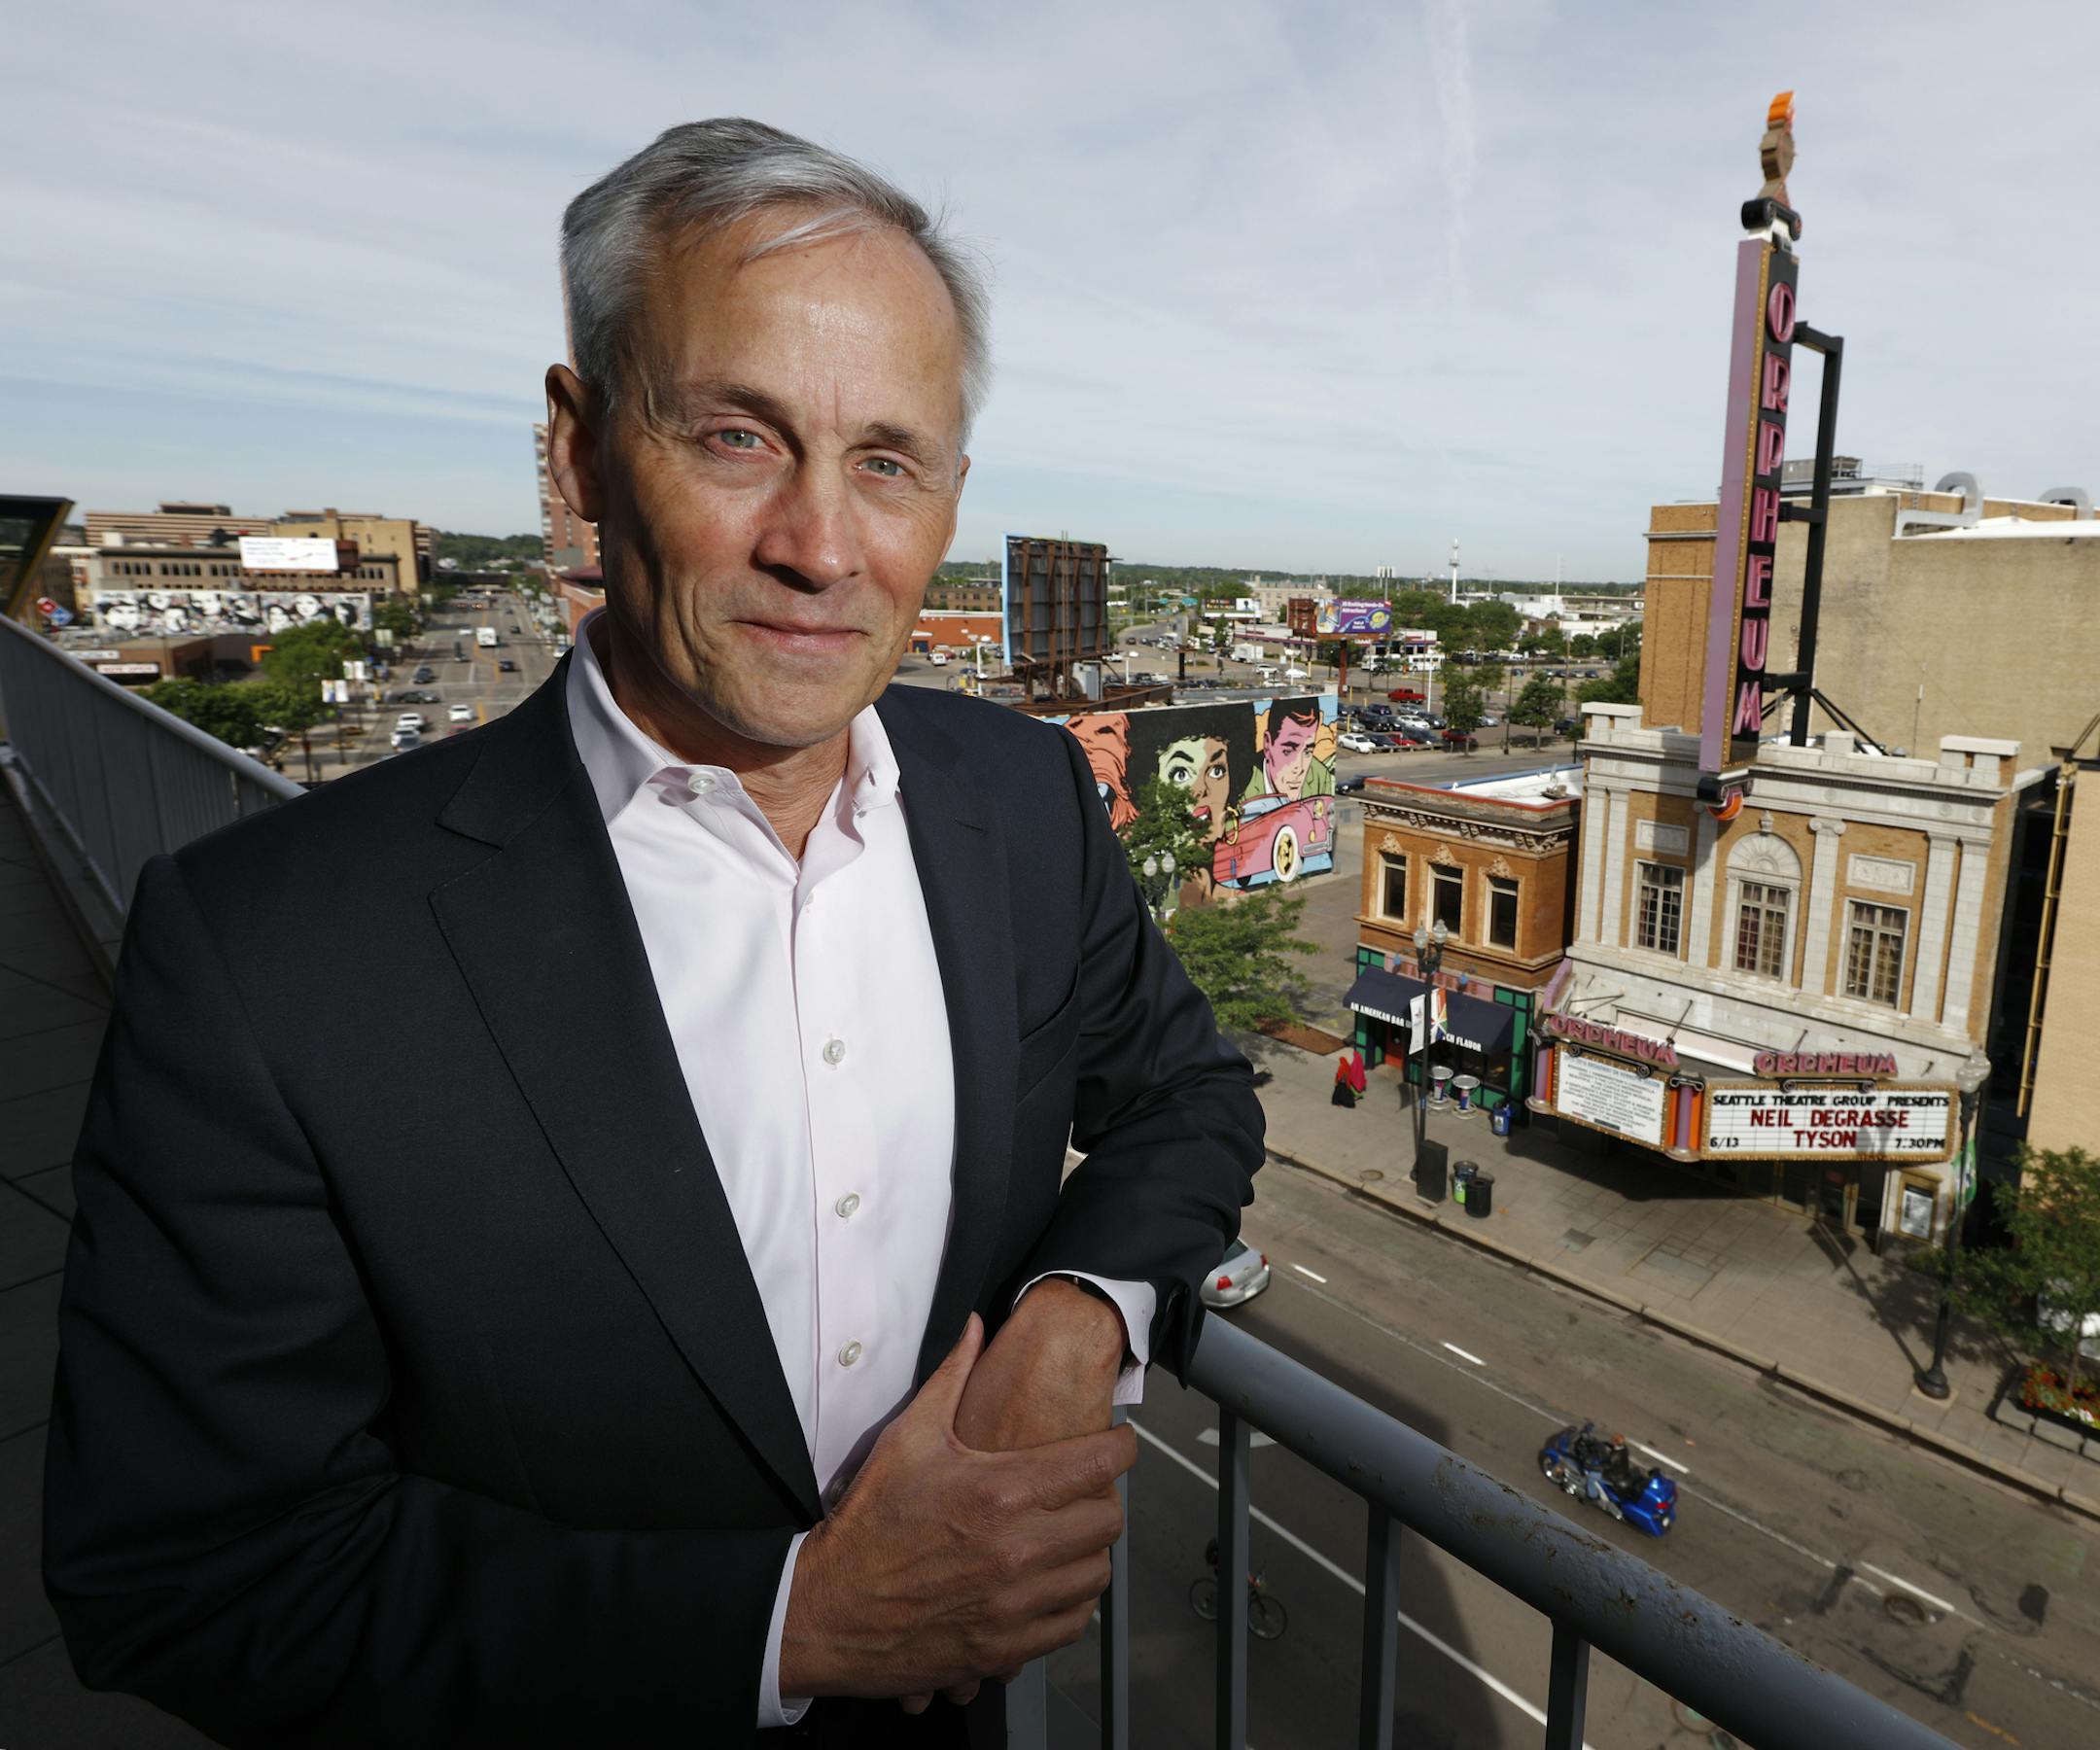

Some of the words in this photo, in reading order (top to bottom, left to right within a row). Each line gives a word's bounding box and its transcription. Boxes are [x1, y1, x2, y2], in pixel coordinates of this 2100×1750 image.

[1733, 281, 1797, 736] ORPHEUM
[1350, 1001, 1360, 1012] AN
[1359, 1004, 1391, 1023] AMERICAN
[1391, 1015, 1405, 1028] BAR
[1550, 1014, 1680, 1067] ORPHEUM
[1754, 1050, 1898, 1074] ORPHEUM
[1713, 1095, 1766, 1106] SEATTLE
[1772, 1095, 1827, 1106] THEATRE
[1833, 1095, 1876, 1106] GROUP
[1887, 1096, 1949, 1107] PRESENTS
[1749, 1109, 1794, 1128] NEIL
[1810, 1109, 1910, 1128] DEGRASSE
[1710, 1137, 1739, 1148] 6/13
[1793, 1130, 1857, 1148] TYSON
